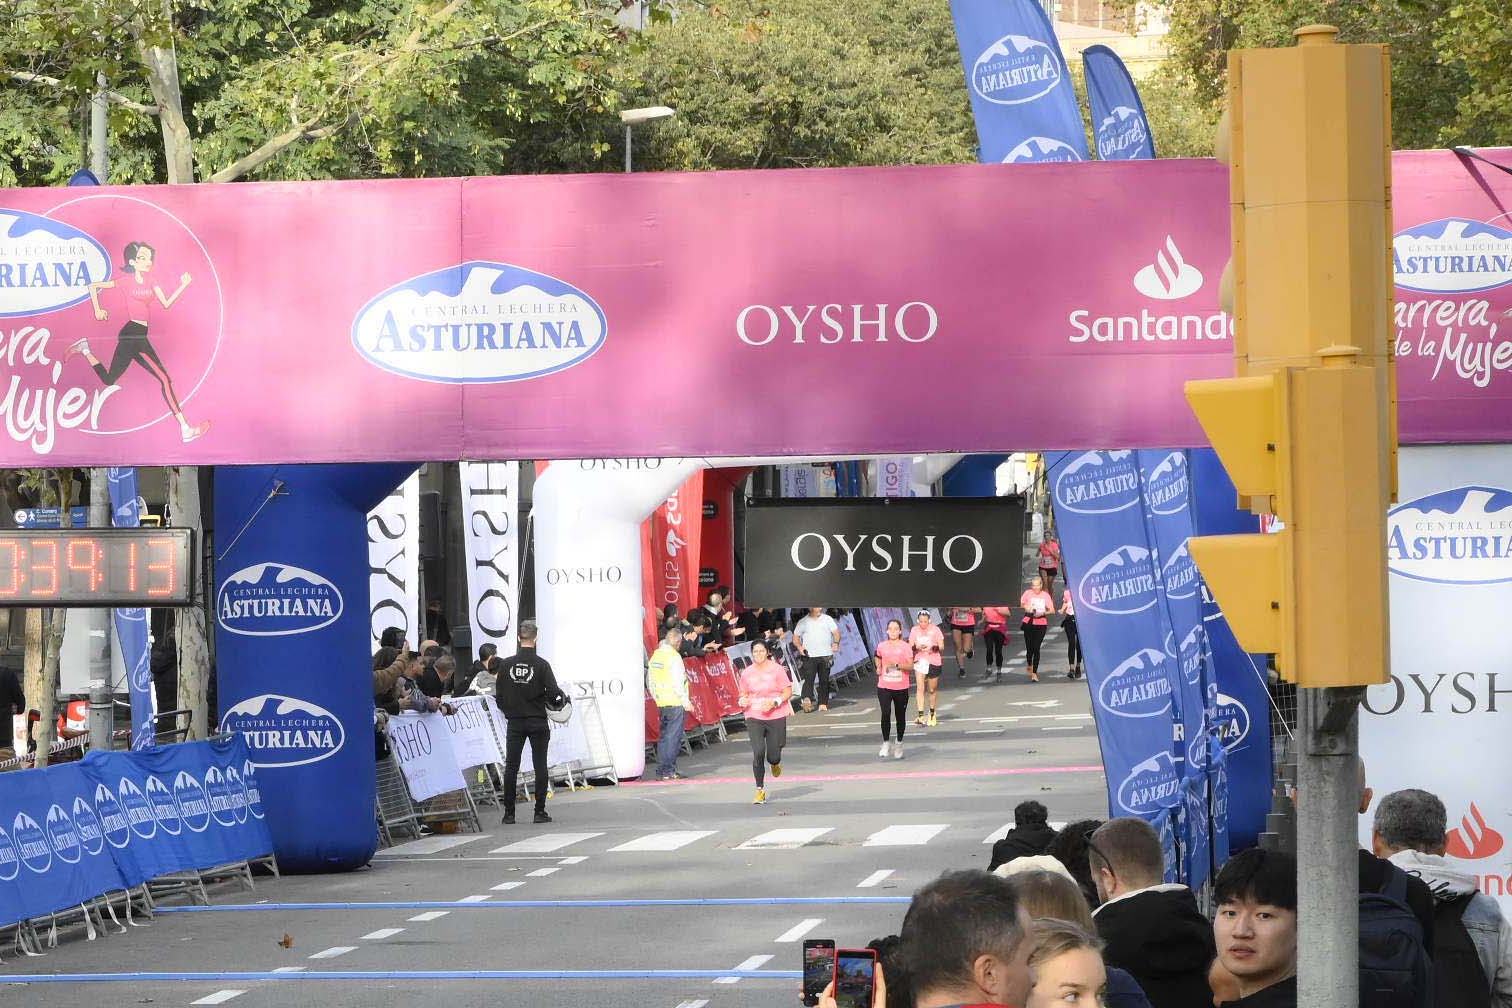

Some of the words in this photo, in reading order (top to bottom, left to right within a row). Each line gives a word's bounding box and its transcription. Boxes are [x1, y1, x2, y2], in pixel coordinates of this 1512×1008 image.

[15, 245, 86, 256] LECHERA
[1394, 245, 1512, 274] ASTURIAN
[1408, 244, 1460, 253] CENTRAL
[1465, 242, 1512, 252] LECHER
[411, 305, 488, 317] CENTRAL
[498, 302, 578, 314] LECHERA
[1394, 299, 1489, 327] arrera
[372, 309, 587, 352] ASTURIANA
[736, 302, 938, 345] OYSHO
[1069, 309, 1235, 342] Santand
[1418, 329, 1436, 356] la
[1432, 323, 1512, 388] Muje
[1415, 521, 1481, 530] CENTRAL
[791, 533, 983, 573] OYSHO
[1388, 524, 1512, 560] ASTURI
[547, 566, 621, 585] OYSHO
[234, 588, 275, 596] CENTRAL
[281, 587, 329, 595] LECHERA
[222, 593, 334, 619] ASTURIANA
[515, 668, 529, 676] BP
[577, 679, 624, 697] SHO
[1361, 672, 1512, 715] OYSH
[235, 719, 276, 728] CENTRAL
[281, 719, 330, 727] LECHERA
